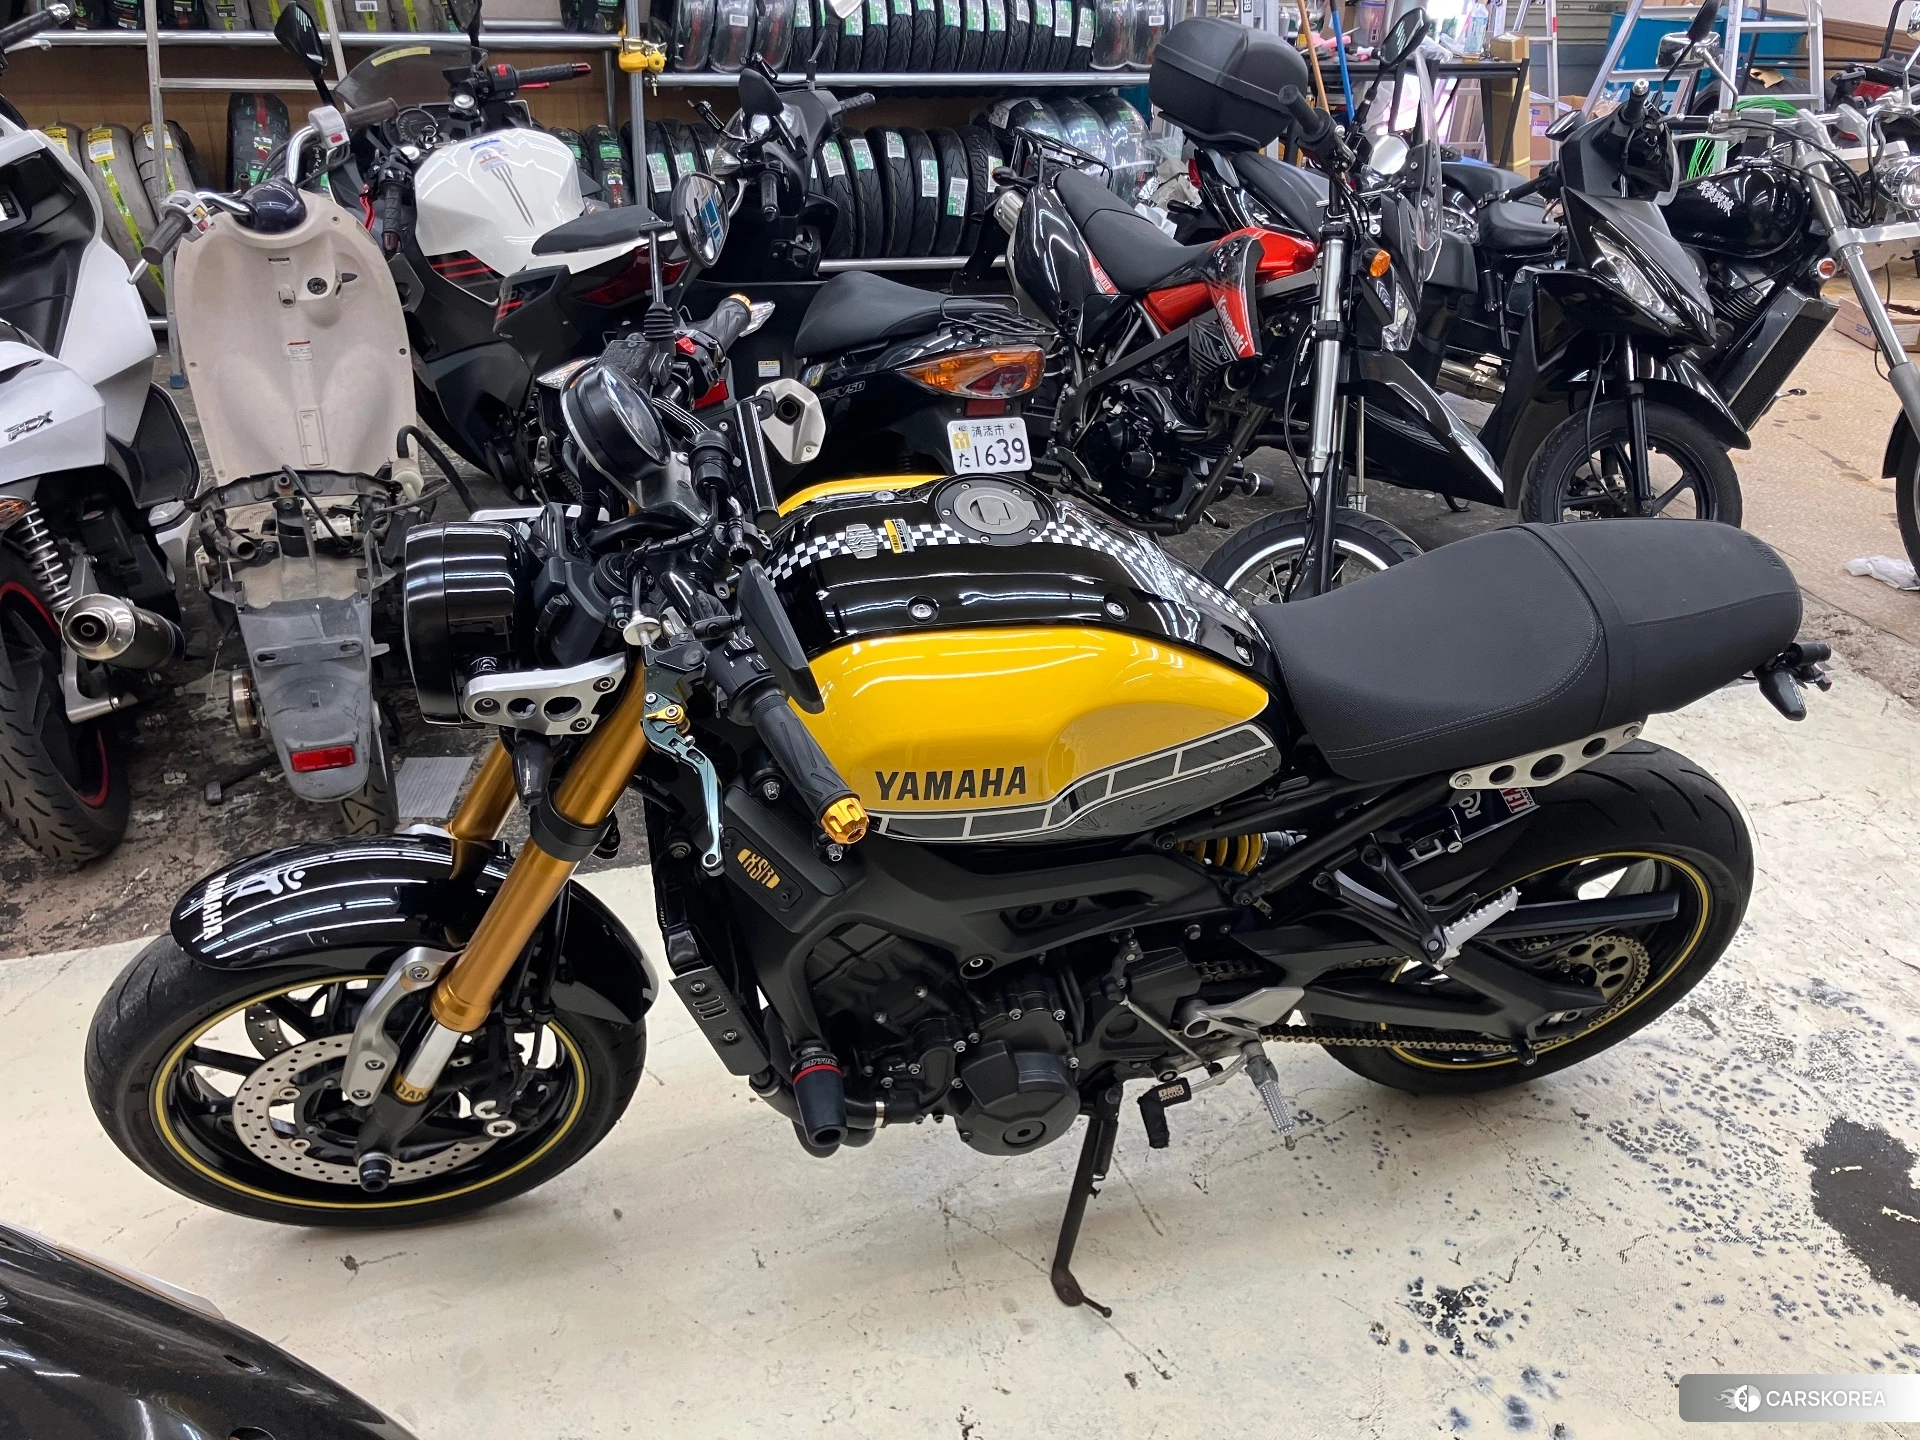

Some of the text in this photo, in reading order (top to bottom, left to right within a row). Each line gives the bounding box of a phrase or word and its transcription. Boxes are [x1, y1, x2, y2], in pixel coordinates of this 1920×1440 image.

[1216, 294, 1248, 355] Kawasaki
[972, 425, 1004, 437] 浦添市
[959, 438, 1027, 468] た 1639
[875, 766, 1027, 801] YAMAHA
[742, 853, 775, 884] XSR
[202, 872, 229, 941] YAMAHA
